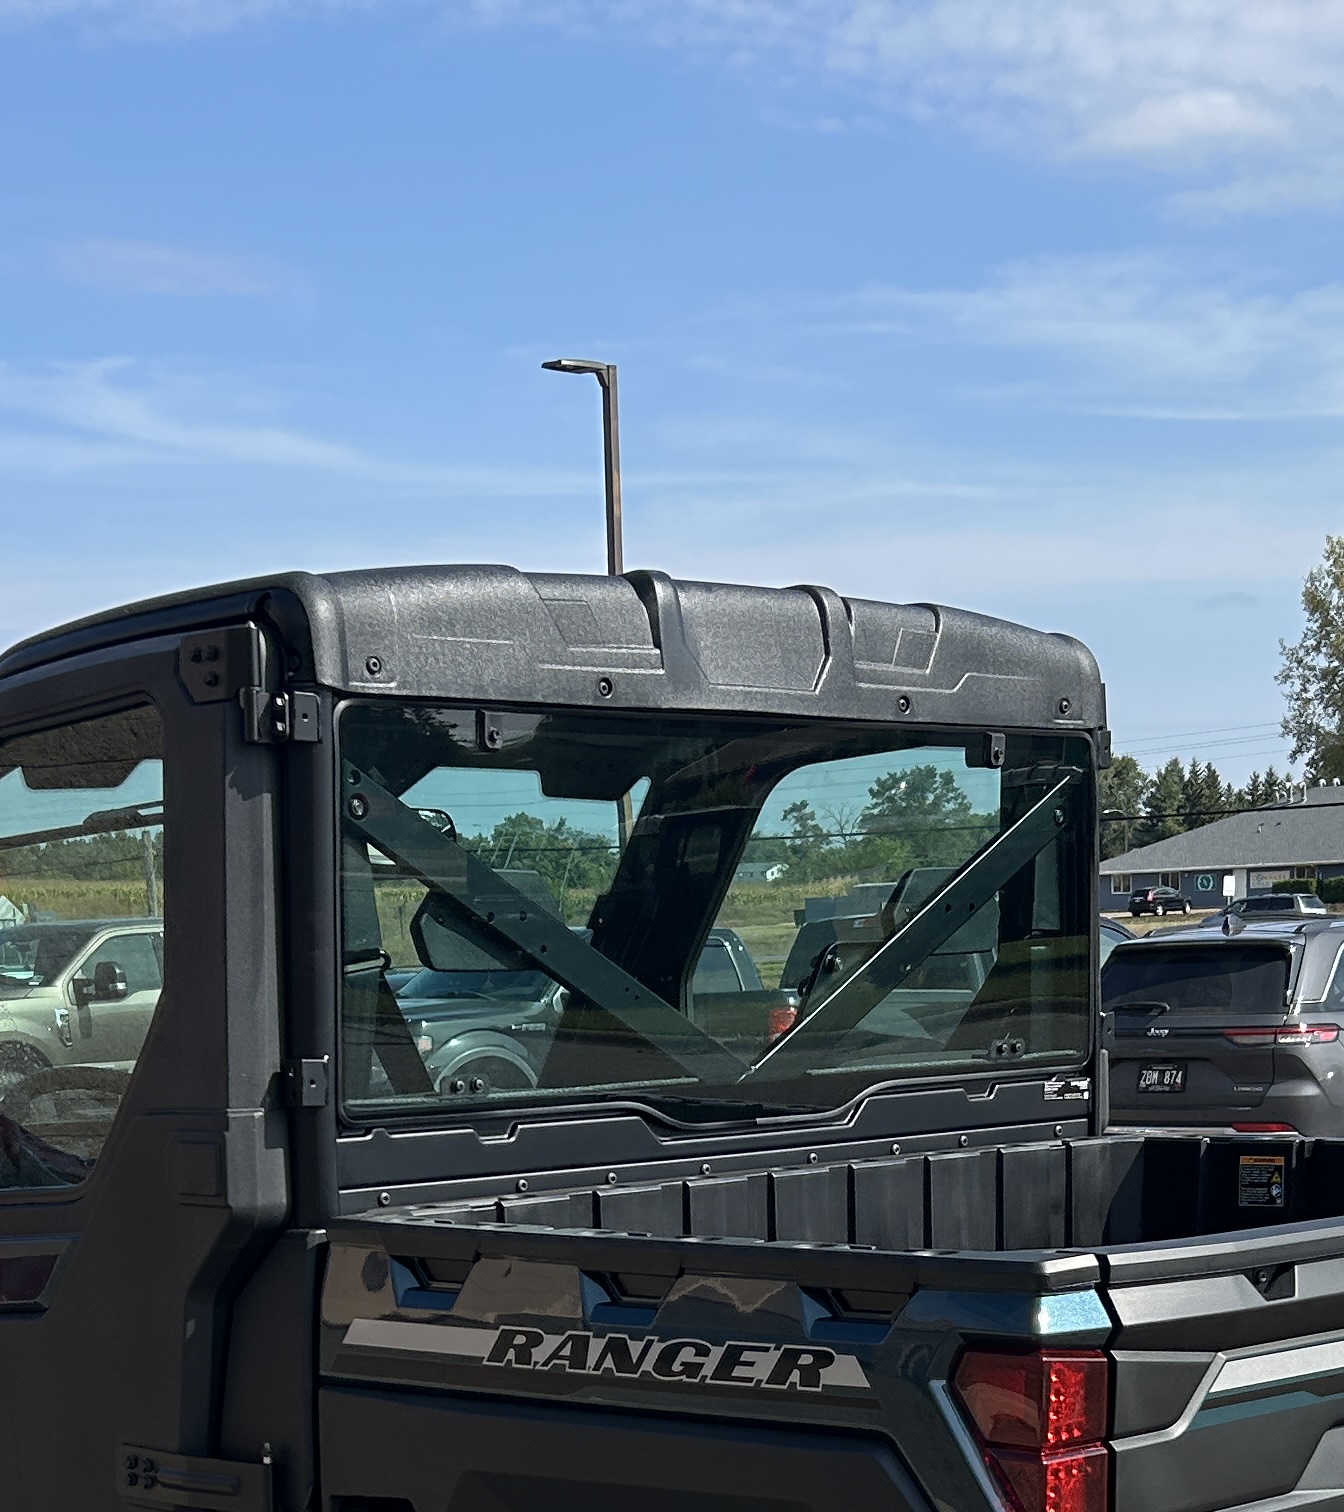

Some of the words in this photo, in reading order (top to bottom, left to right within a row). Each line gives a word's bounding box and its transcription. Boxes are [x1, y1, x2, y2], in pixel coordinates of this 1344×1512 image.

[1147, 1028, 1170, 1038] Jeep
[1163, 1070, 1183, 1085] 874
[482, 1325, 836, 1391] RANGER
